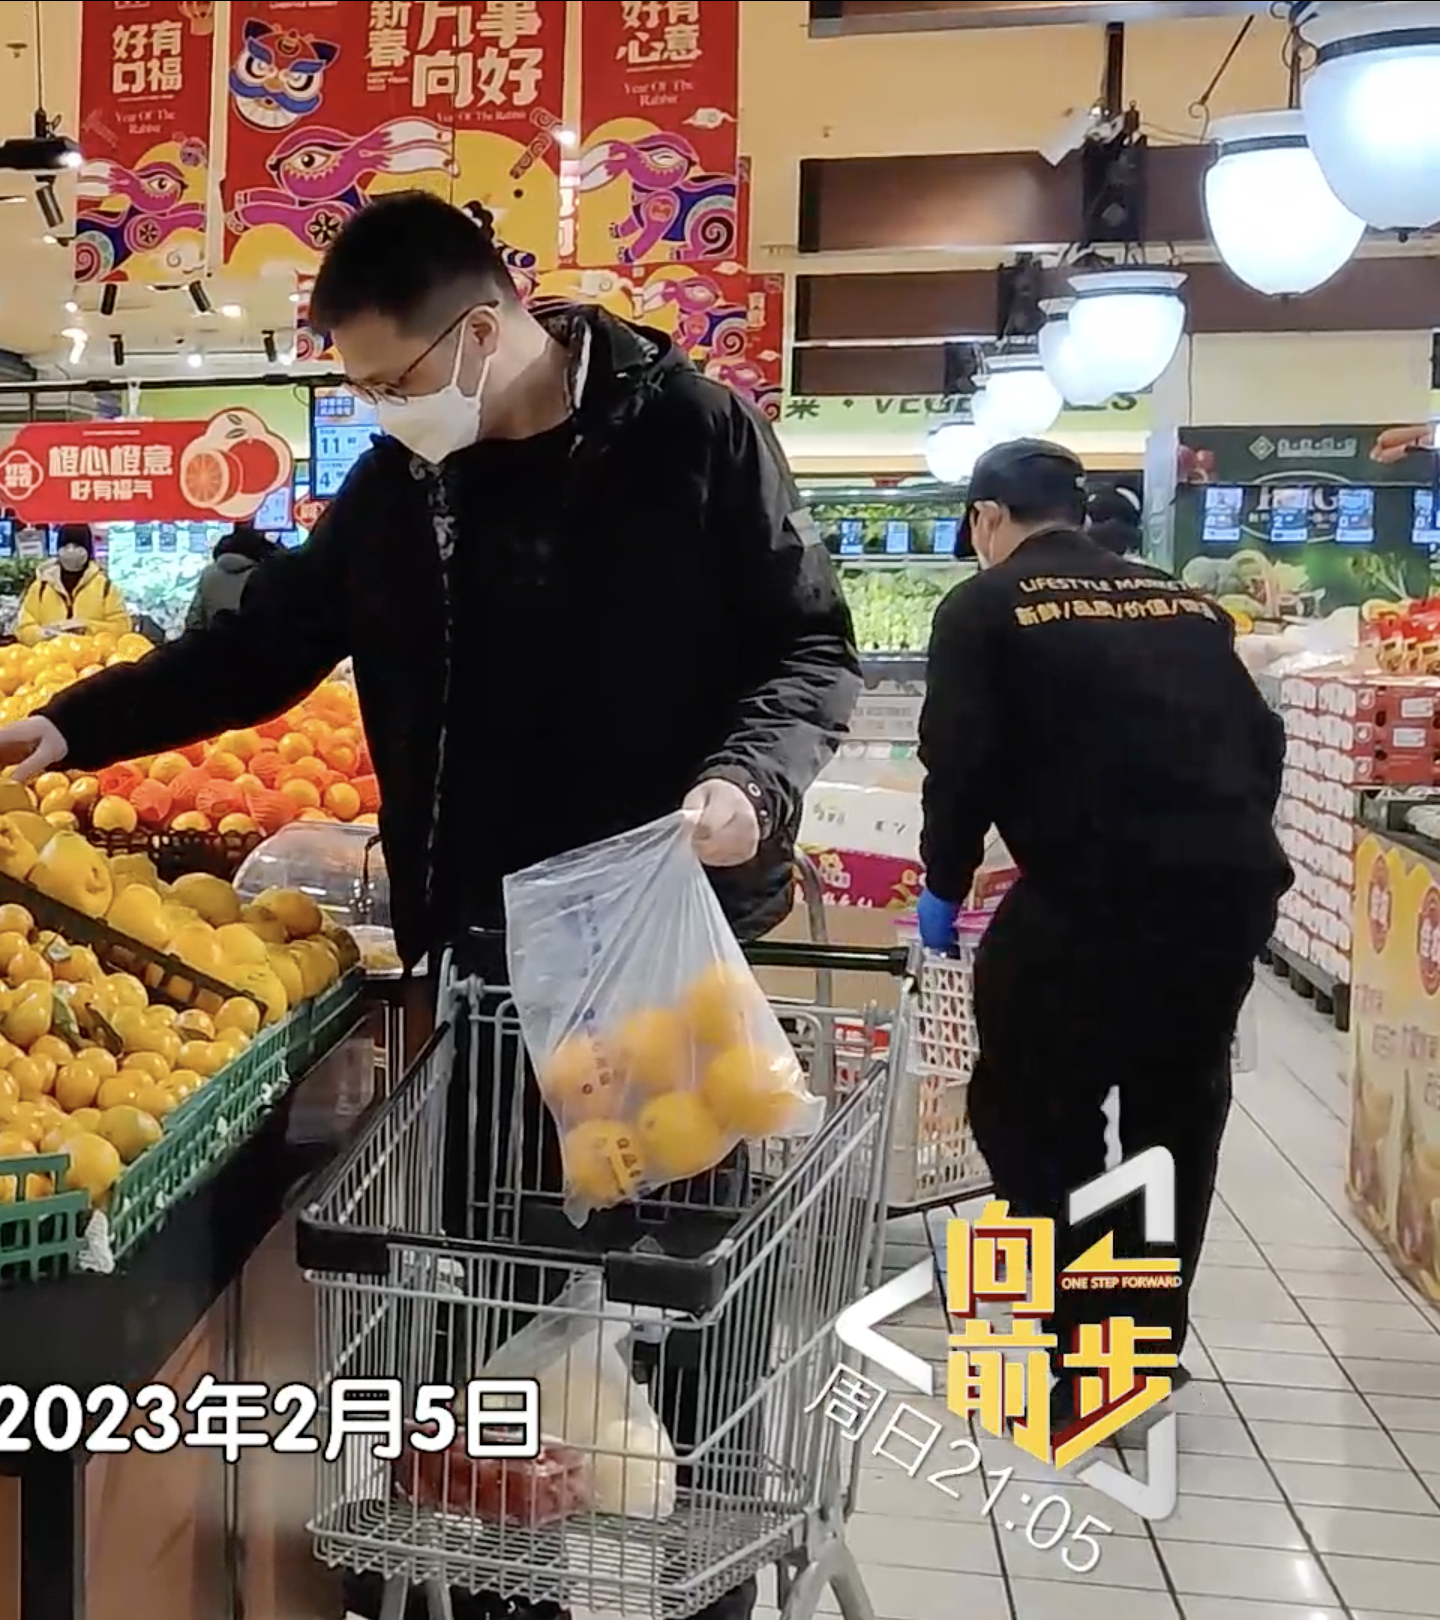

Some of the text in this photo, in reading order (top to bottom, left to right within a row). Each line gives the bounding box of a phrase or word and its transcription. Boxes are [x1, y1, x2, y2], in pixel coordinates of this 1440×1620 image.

[112, 20, 183, 60] 好有
[615, 23, 703, 64] 心意
[112, 57, 183, 94] 口福
[412, 46, 543, 109] 向好
[49, 445, 173, 477] 橙心橙意
